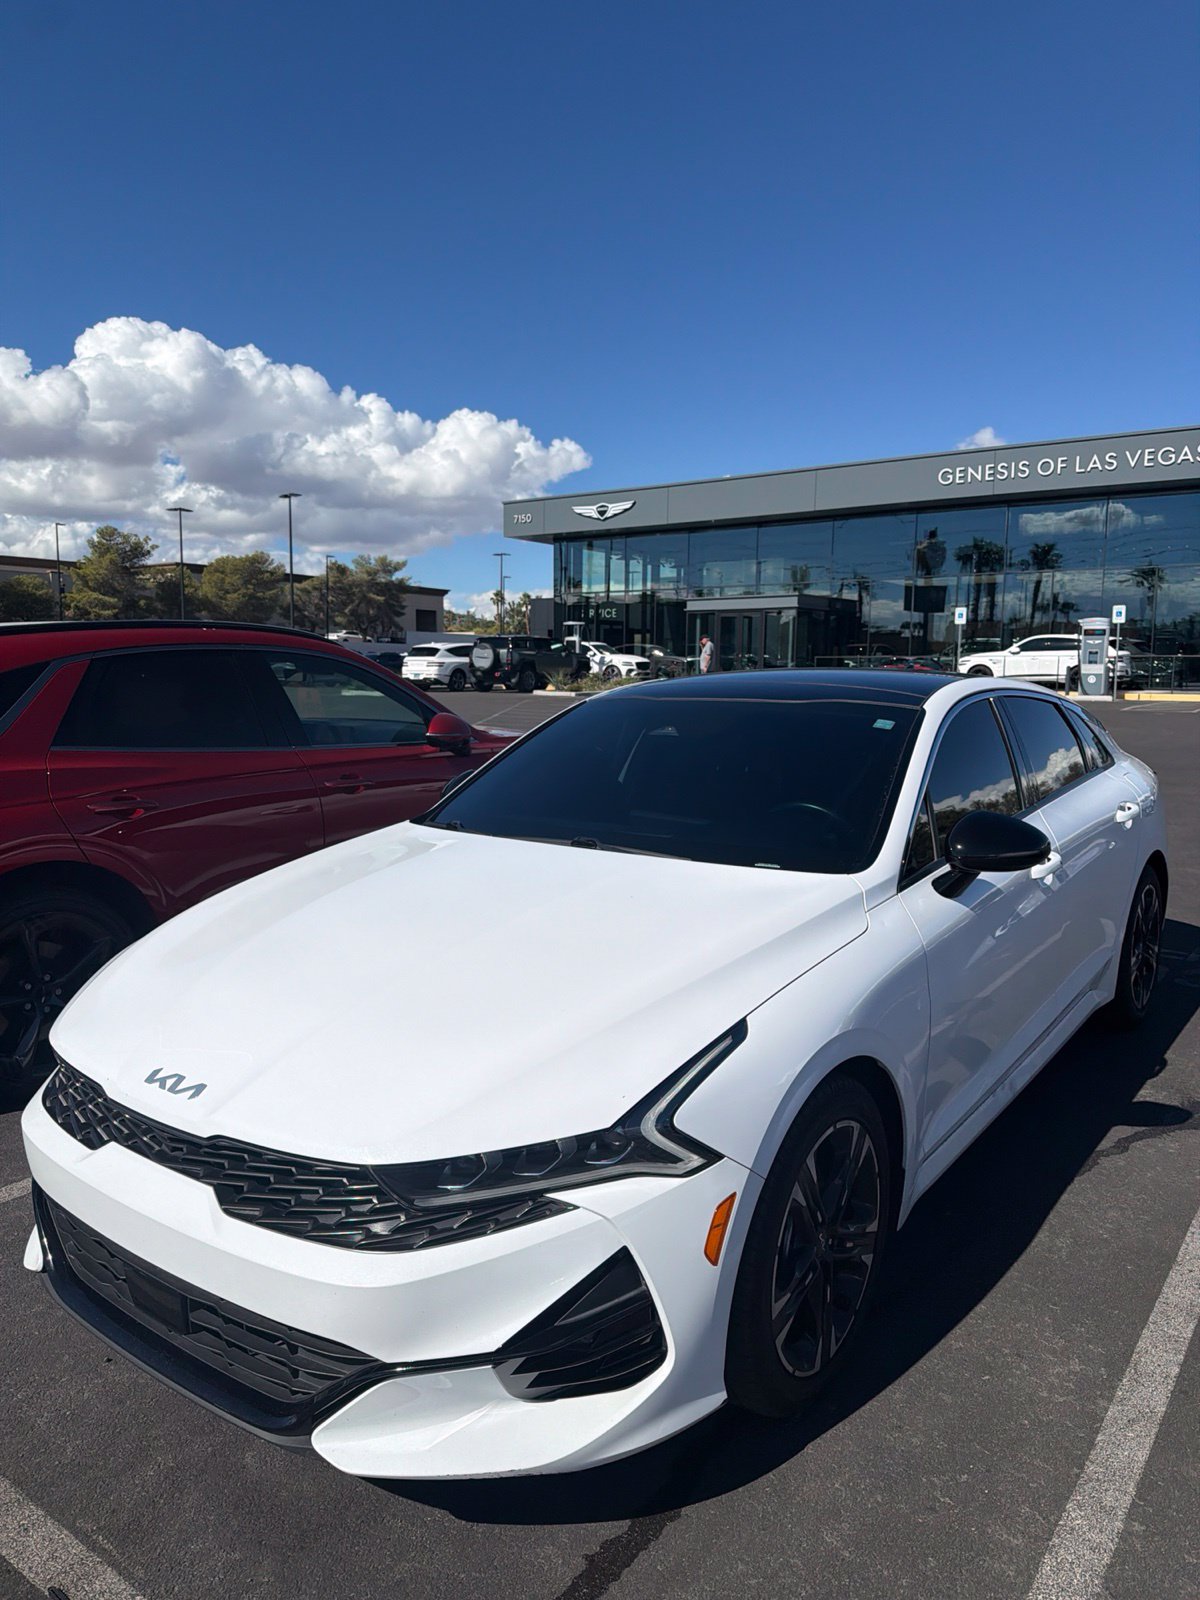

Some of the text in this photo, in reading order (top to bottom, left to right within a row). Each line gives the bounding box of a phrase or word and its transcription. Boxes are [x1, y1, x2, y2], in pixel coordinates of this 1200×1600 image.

[938, 460, 1030, 485] GENESIS
[1037, 457, 1068, 476] OF
[1075, 452, 1118, 473] LAS
[513, 513, 532, 524] 7150
[144, 1067, 208, 1100] KIA
